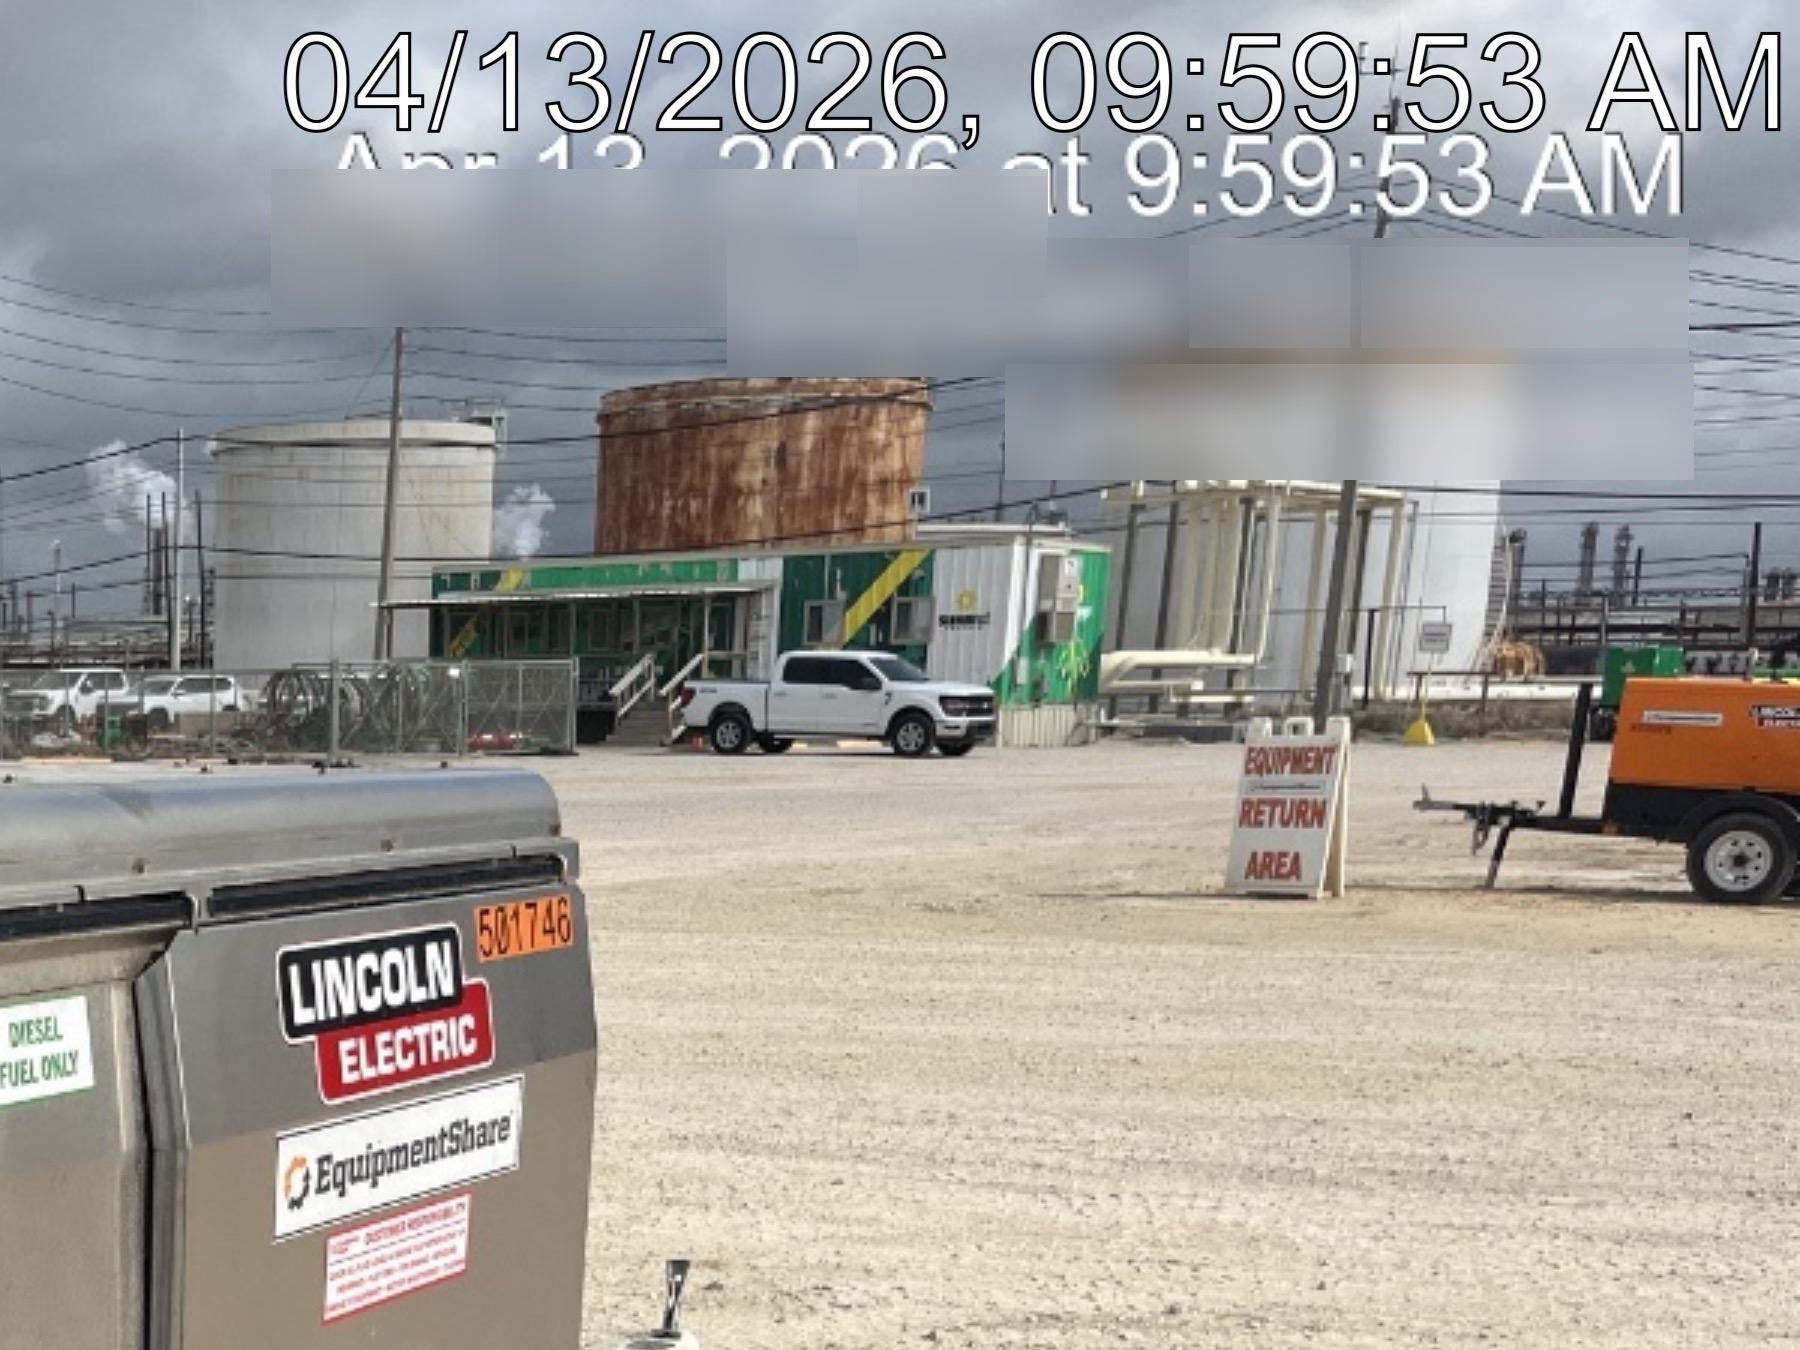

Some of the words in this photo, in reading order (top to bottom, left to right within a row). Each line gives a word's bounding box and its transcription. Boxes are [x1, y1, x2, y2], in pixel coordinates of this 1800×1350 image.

[1244, 746, 1337, 777] EQUIPMENT
[1238, 797, 1327, 829] RETURN
[1244, 851, 1303, 880] AREA
[479, 896, 572, 957] 501746
[287, 938, 457, 1025] LINCOLN
[8, 1016, 63, 1048] DIESEL
[339, 1013, 477, 1085] ELECTRIC
[0, 1059, 39, 1088] FUEL
[42, 1049, 79, 1081] ONLY
[315, 1116, 511, 1198] EquipmentShare
